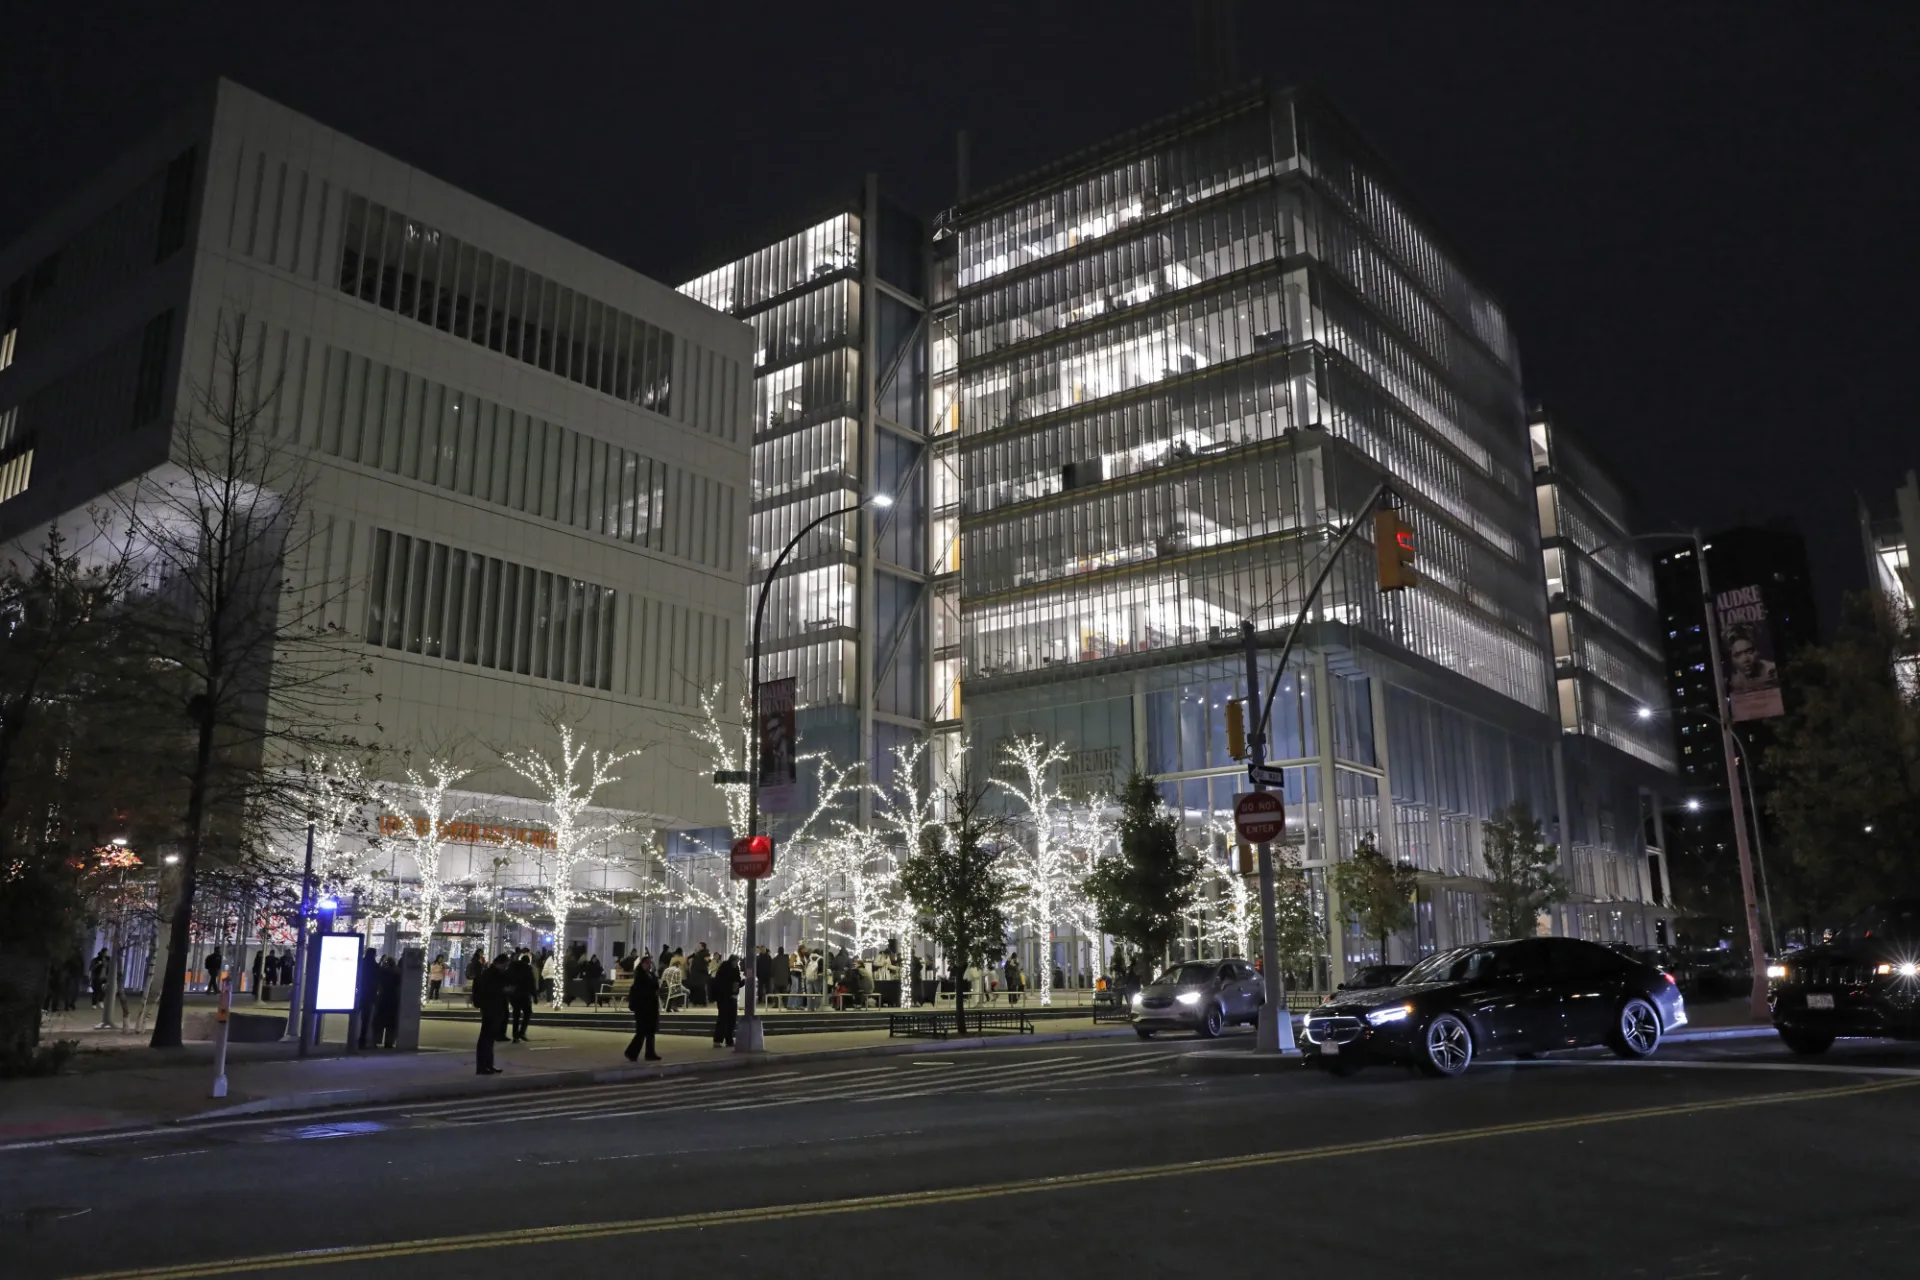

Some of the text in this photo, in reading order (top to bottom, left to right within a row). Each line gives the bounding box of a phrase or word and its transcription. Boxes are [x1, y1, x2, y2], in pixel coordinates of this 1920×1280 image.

[1717, 584, 1760, 610] AUDRE
[1720, 602, 1766, 628] LORDE
[1269, 773, 1280, 781] WAY
[1241, 801, 1277, 813] DO NOT
[1246, 823, 1275, 835] ENTER
[739, 863, 762, 873] ENTER
